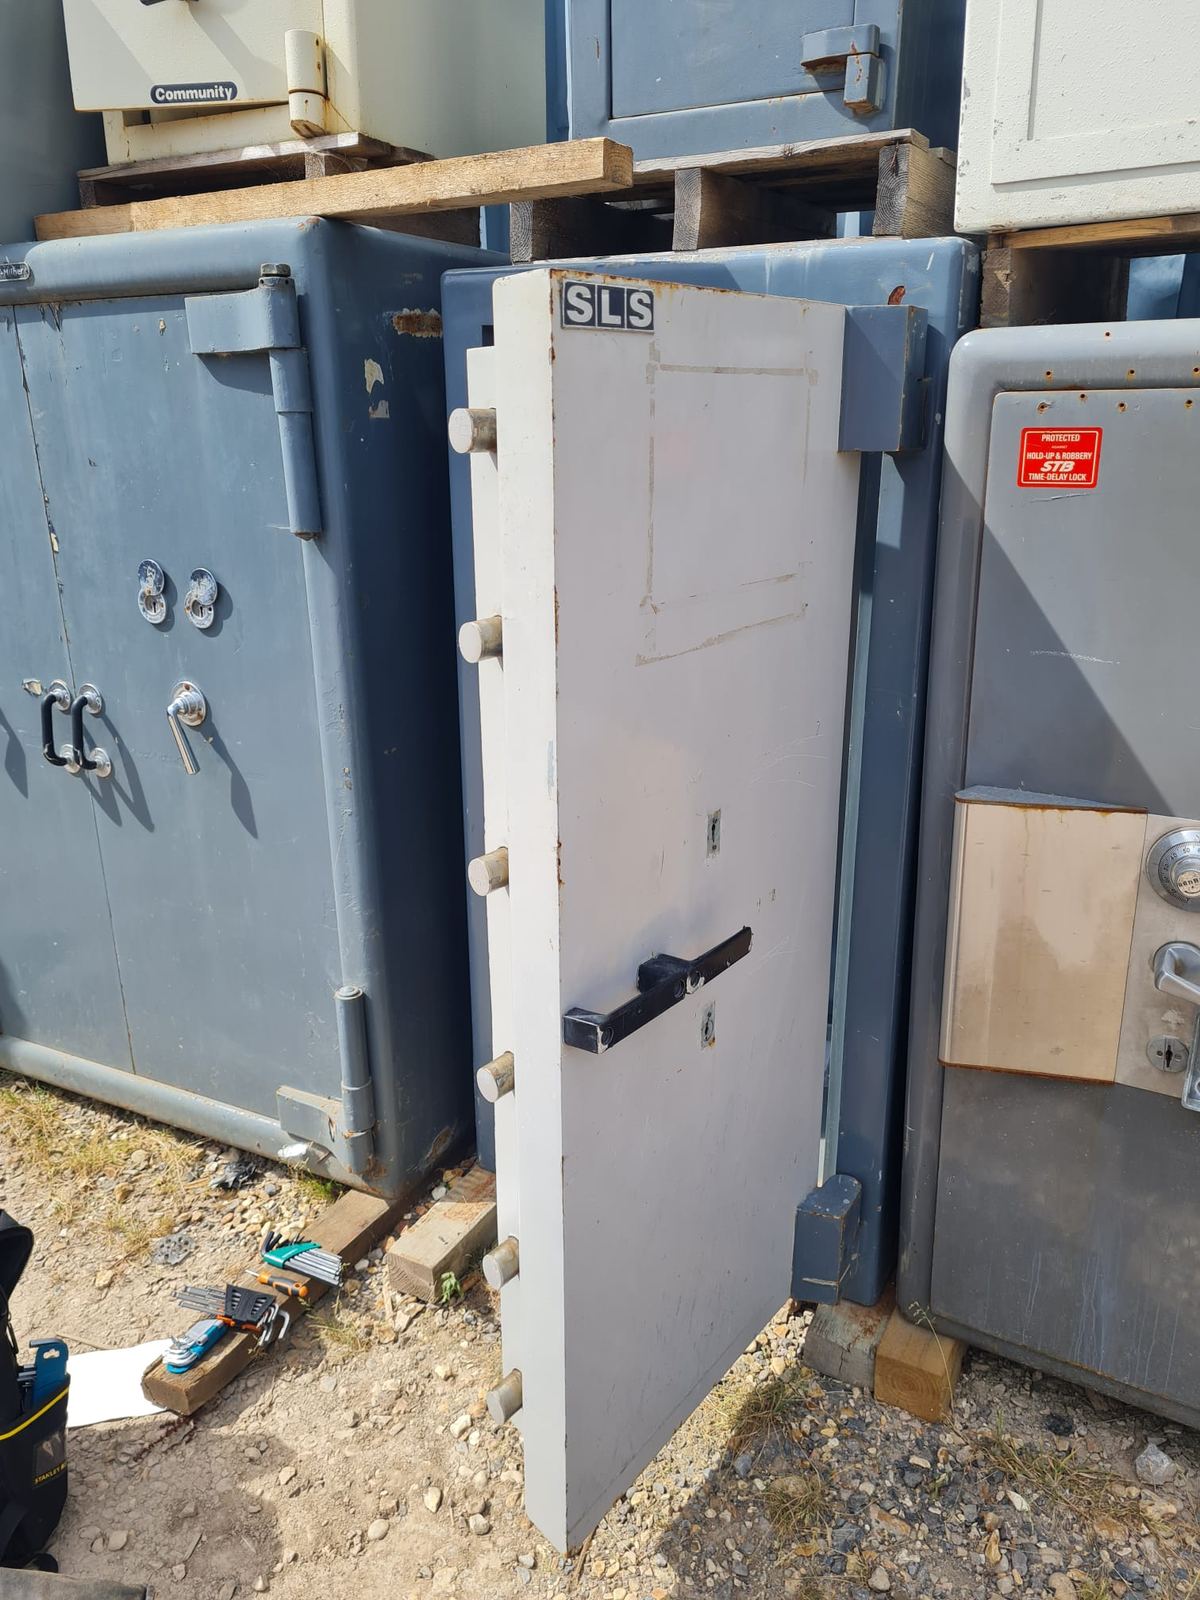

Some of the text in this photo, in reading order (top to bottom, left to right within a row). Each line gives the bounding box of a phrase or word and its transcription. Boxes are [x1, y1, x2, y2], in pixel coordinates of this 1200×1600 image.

[155, 85, 232, 101] Community
[566, 285, 652, 328] SLS
[1041, 434, 1080, 442] PROTECTED
[1026, 452, 1093, 460] HOLD-UP & ROBBERY
[1040, 461, 1075, 472] STB
[1028, 473, 1068, 481] TIME-DELAY
